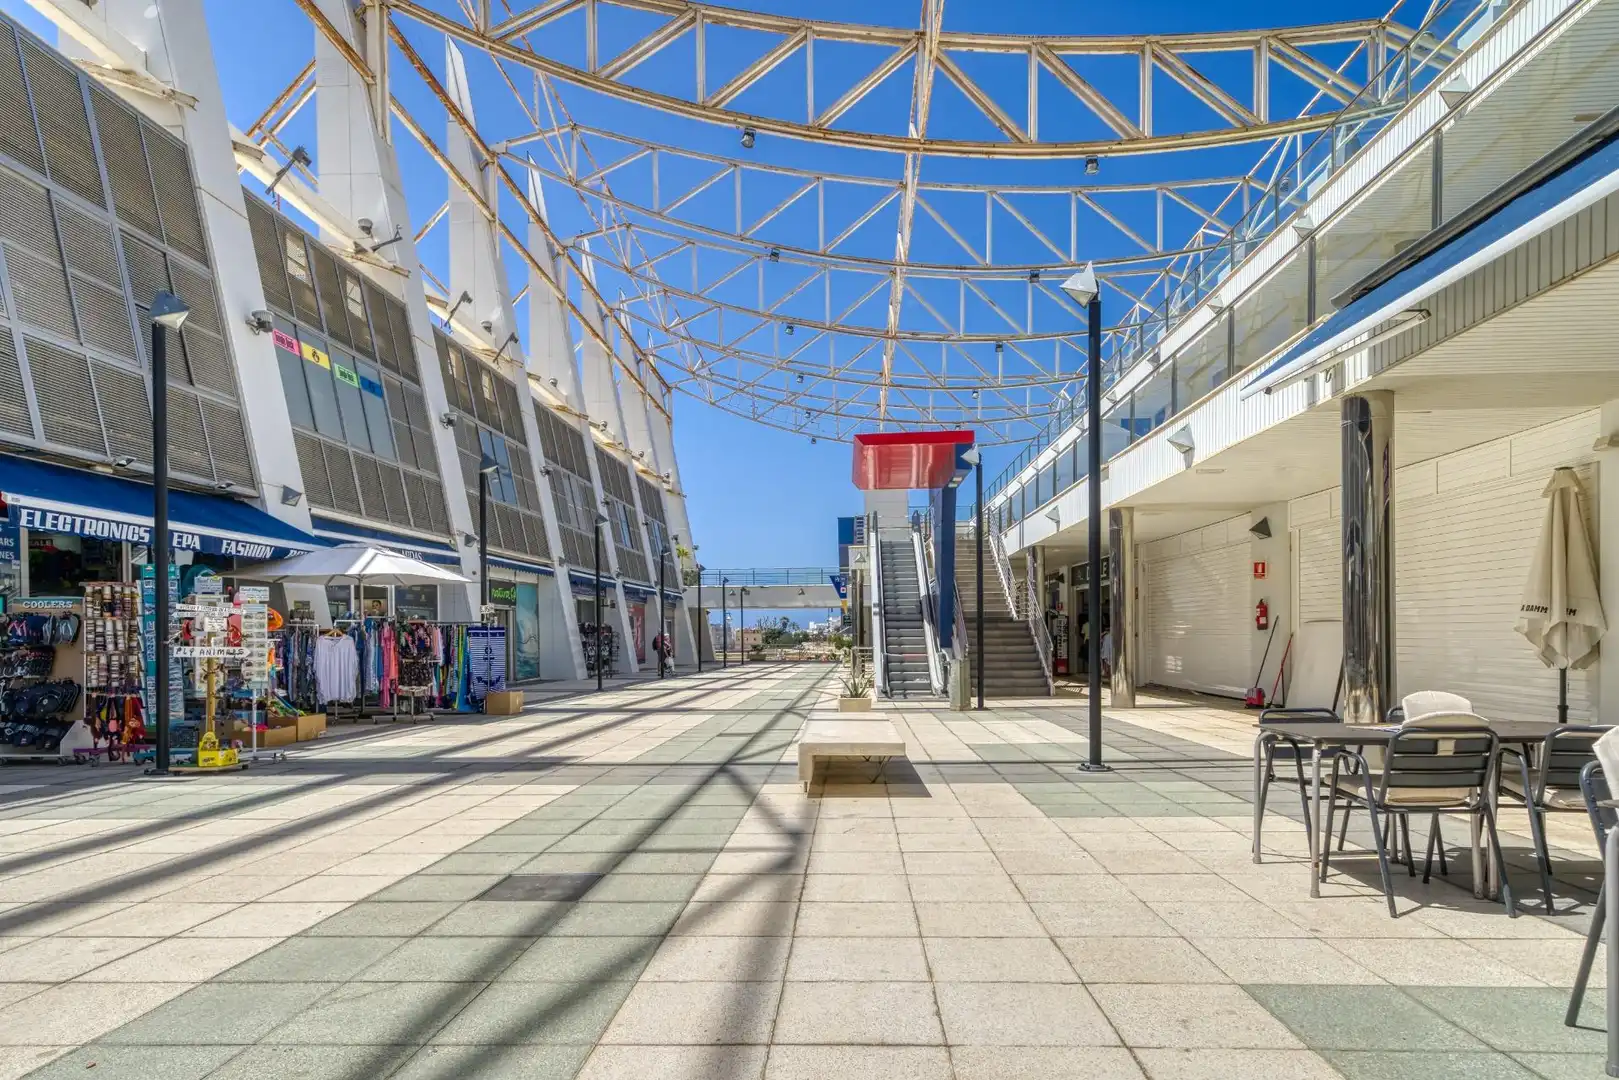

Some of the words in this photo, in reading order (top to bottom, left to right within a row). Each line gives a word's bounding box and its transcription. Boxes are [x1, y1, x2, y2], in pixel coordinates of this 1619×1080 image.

[20, 508, 150, 543] ELECTRONICS
[220, 540, 275, 559] FASHION
[22, 600, 73, 609] COOLERS
